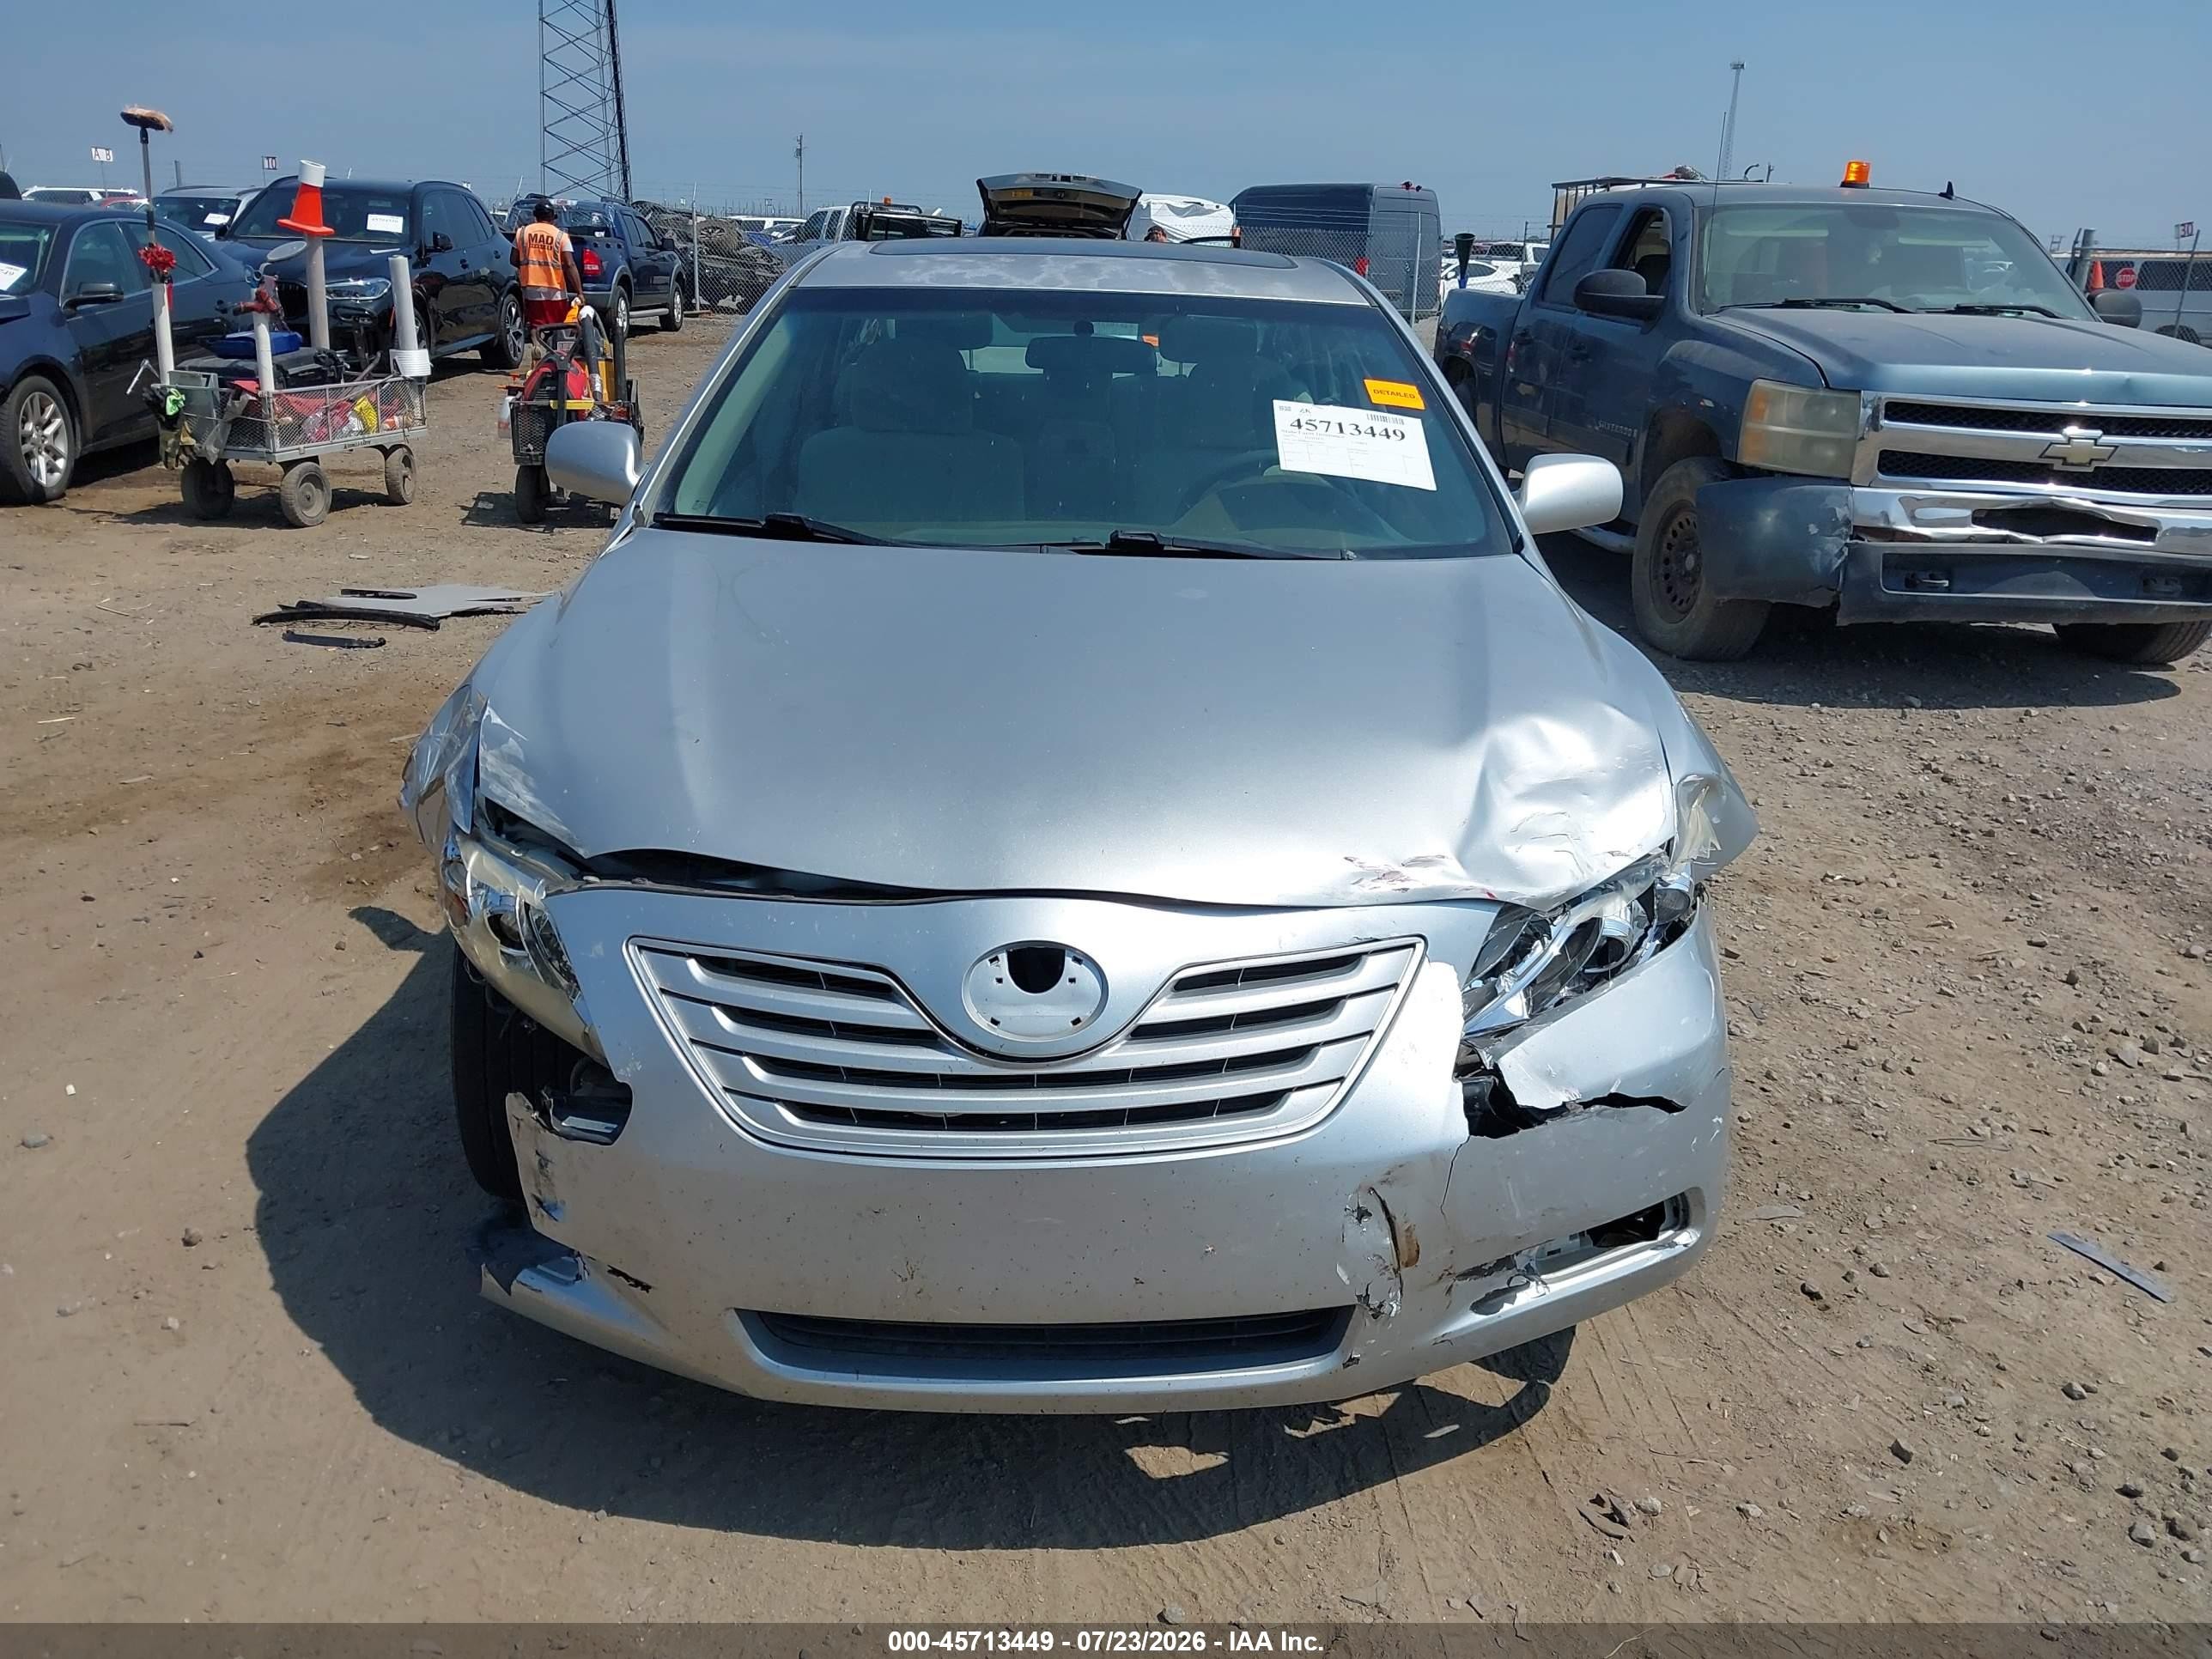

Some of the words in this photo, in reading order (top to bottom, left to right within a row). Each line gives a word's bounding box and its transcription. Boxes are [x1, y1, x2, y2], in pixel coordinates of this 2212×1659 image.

[94, 147, 101, 160] A
[105, 149, 111, 161] B
[2181, 223, 2194, 236] 30
[528, 234, 554, 245] MAD
[2118, 274, 2136, 283] STOP
[1373, 389, 1415, 399] DETAILED
[1290, 418, 1406, 441] 45713449
